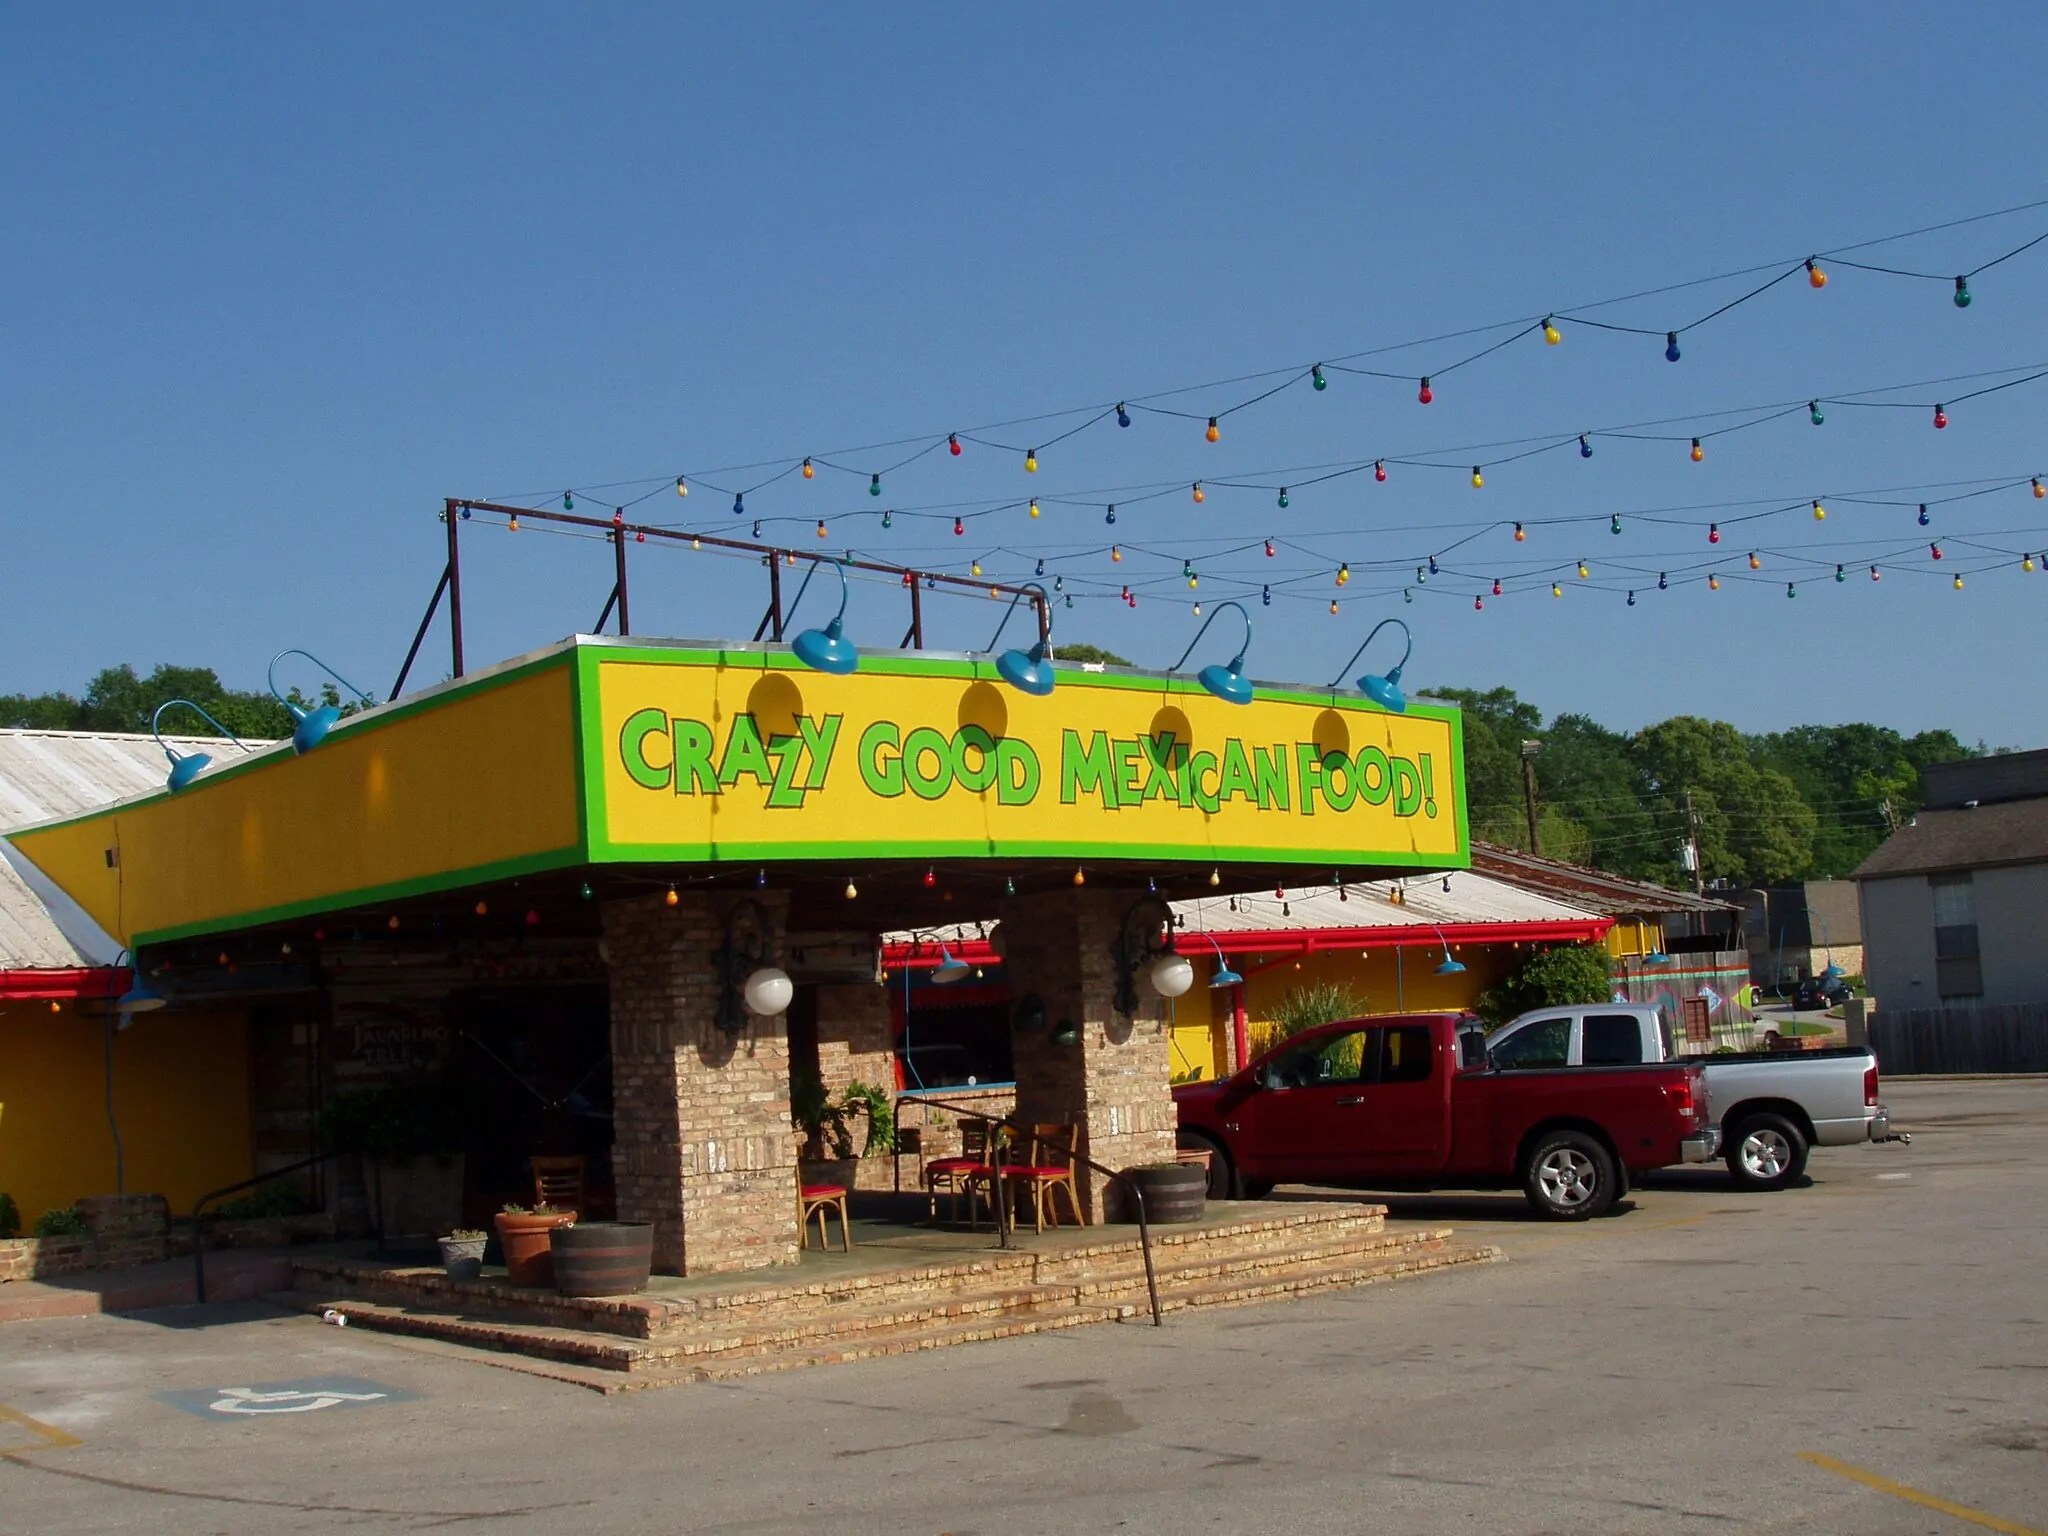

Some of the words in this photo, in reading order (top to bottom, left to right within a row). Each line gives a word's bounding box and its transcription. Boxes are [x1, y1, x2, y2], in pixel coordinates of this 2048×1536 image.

[619, 707, 844, 809] CRAZY
[857, 719, 1041, 807] GOOD
[1059, 728, 1291, 815] MEXICAN
[1296, 741, 1438, 820] FOOD!
